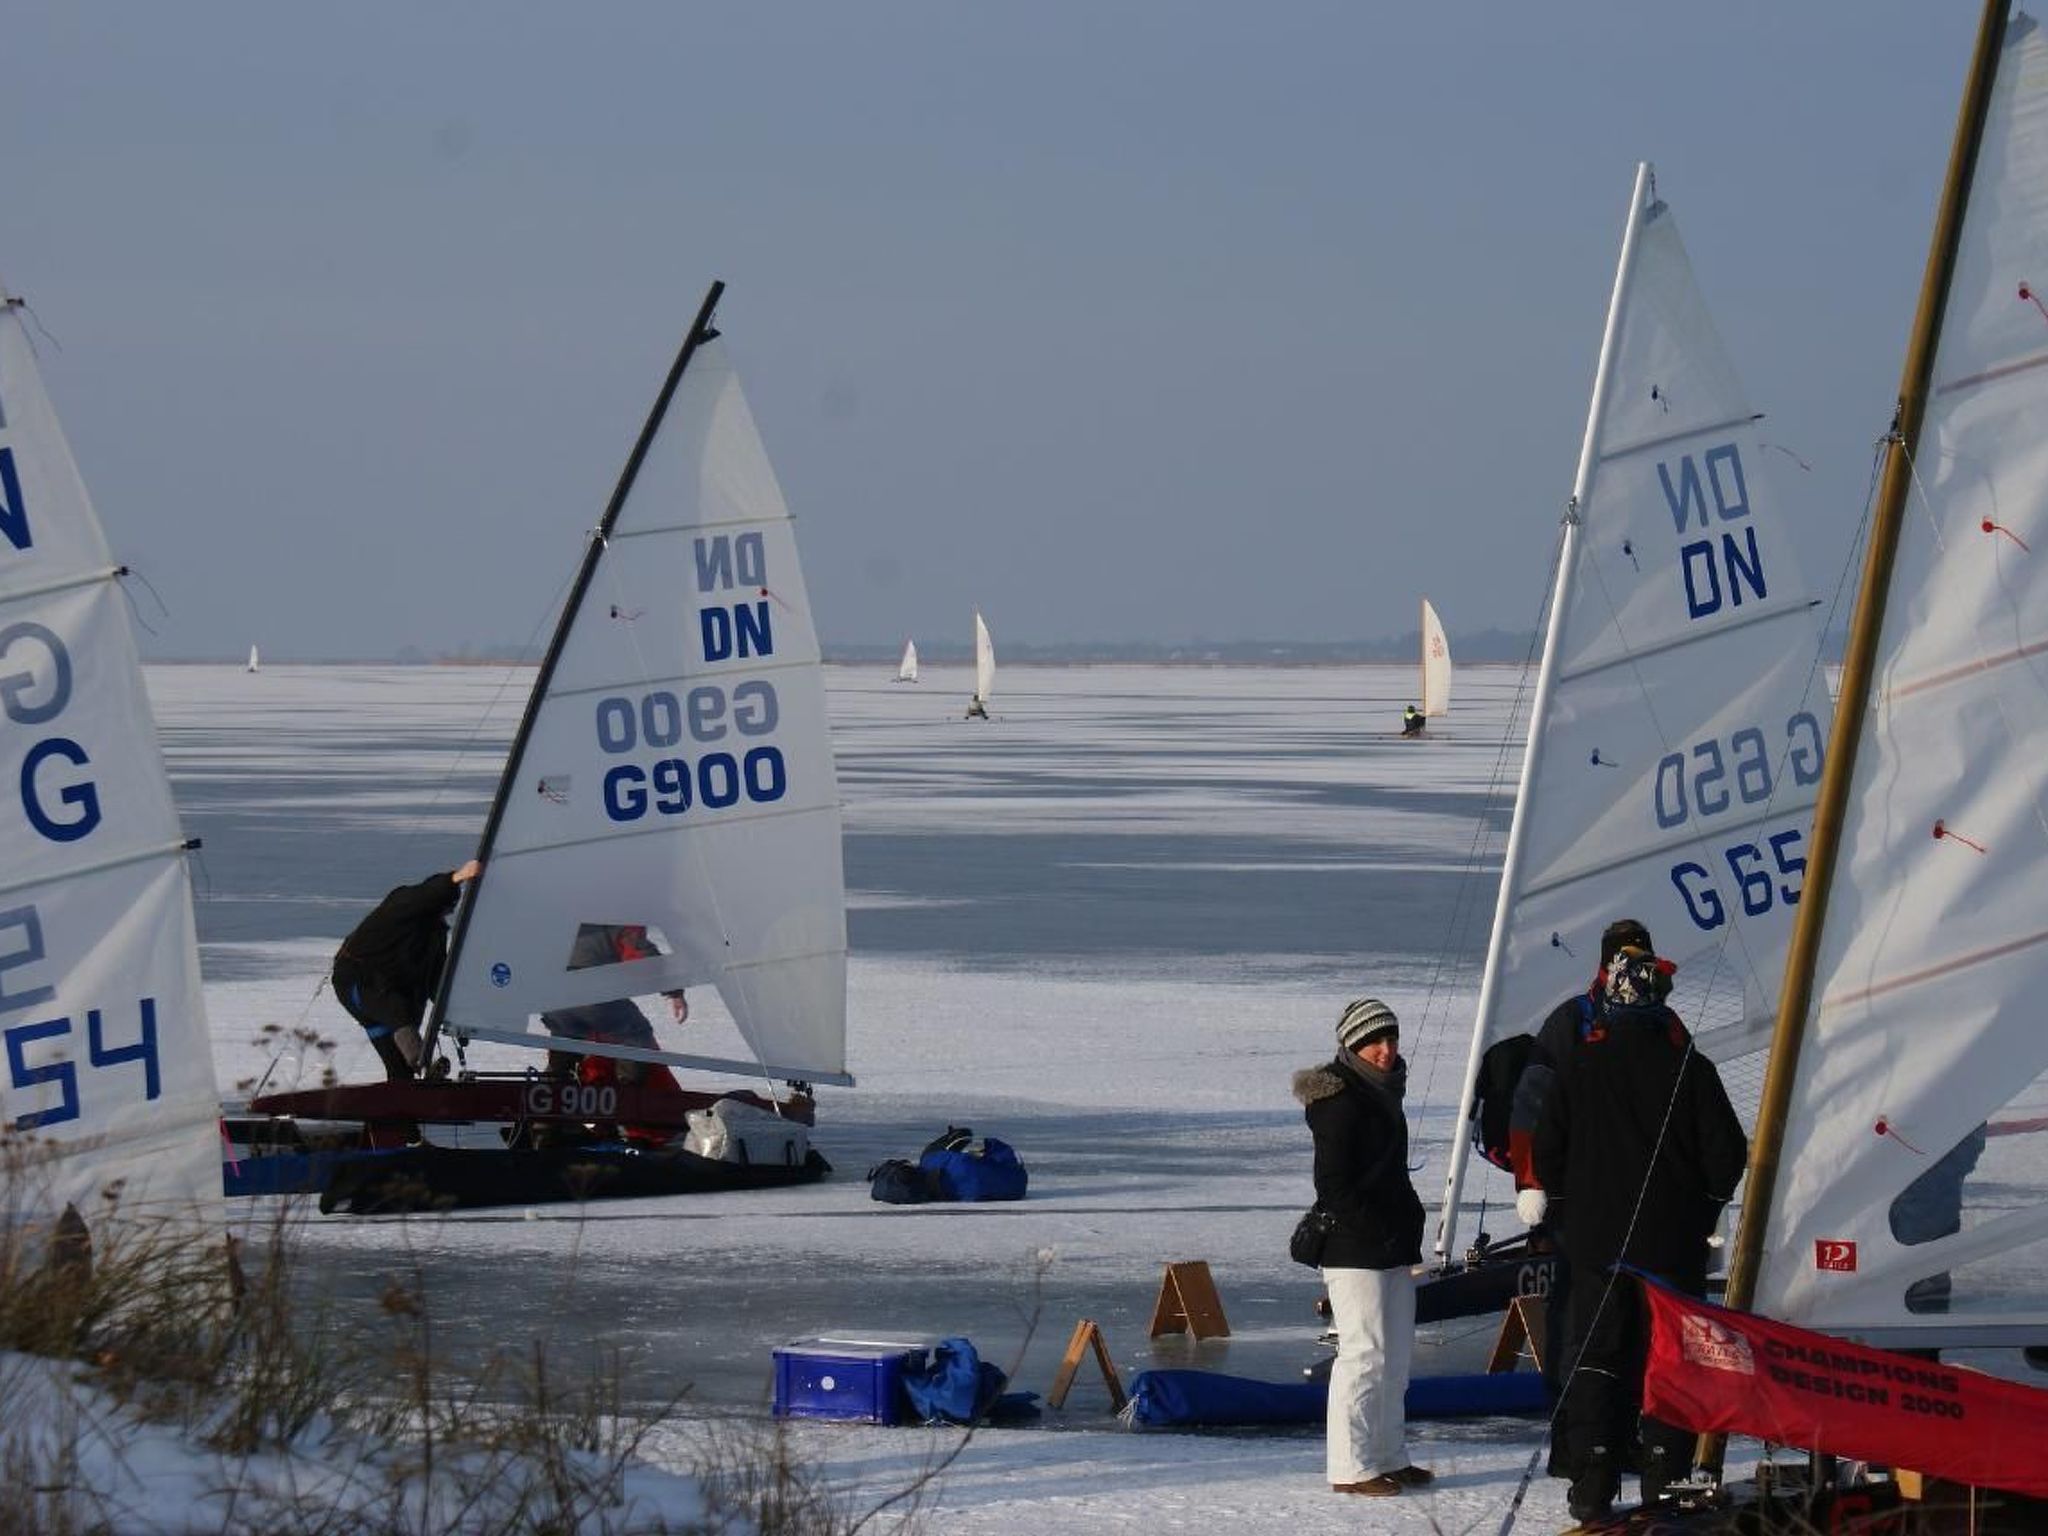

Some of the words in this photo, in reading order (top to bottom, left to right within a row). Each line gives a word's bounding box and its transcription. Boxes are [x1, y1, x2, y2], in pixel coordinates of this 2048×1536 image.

[1681, 527, 1767, 619] DN
[700, 601, 774, 661] DN
[21, 738, 102, 842] G
[604, 746, 786, 821] G900
[1671, 861, 1725, 930] G
[5, 998, 161, 1132] 54
[529, 1085, 553, 1114] G
[561, 1086, 617, 1115] 900
[1763, 1339, 1959, 1393] CHAMPIONS
[1769, 1364, 1889, 1406] DESIGN
[1901, 1392, 1965, 1420] 2000
